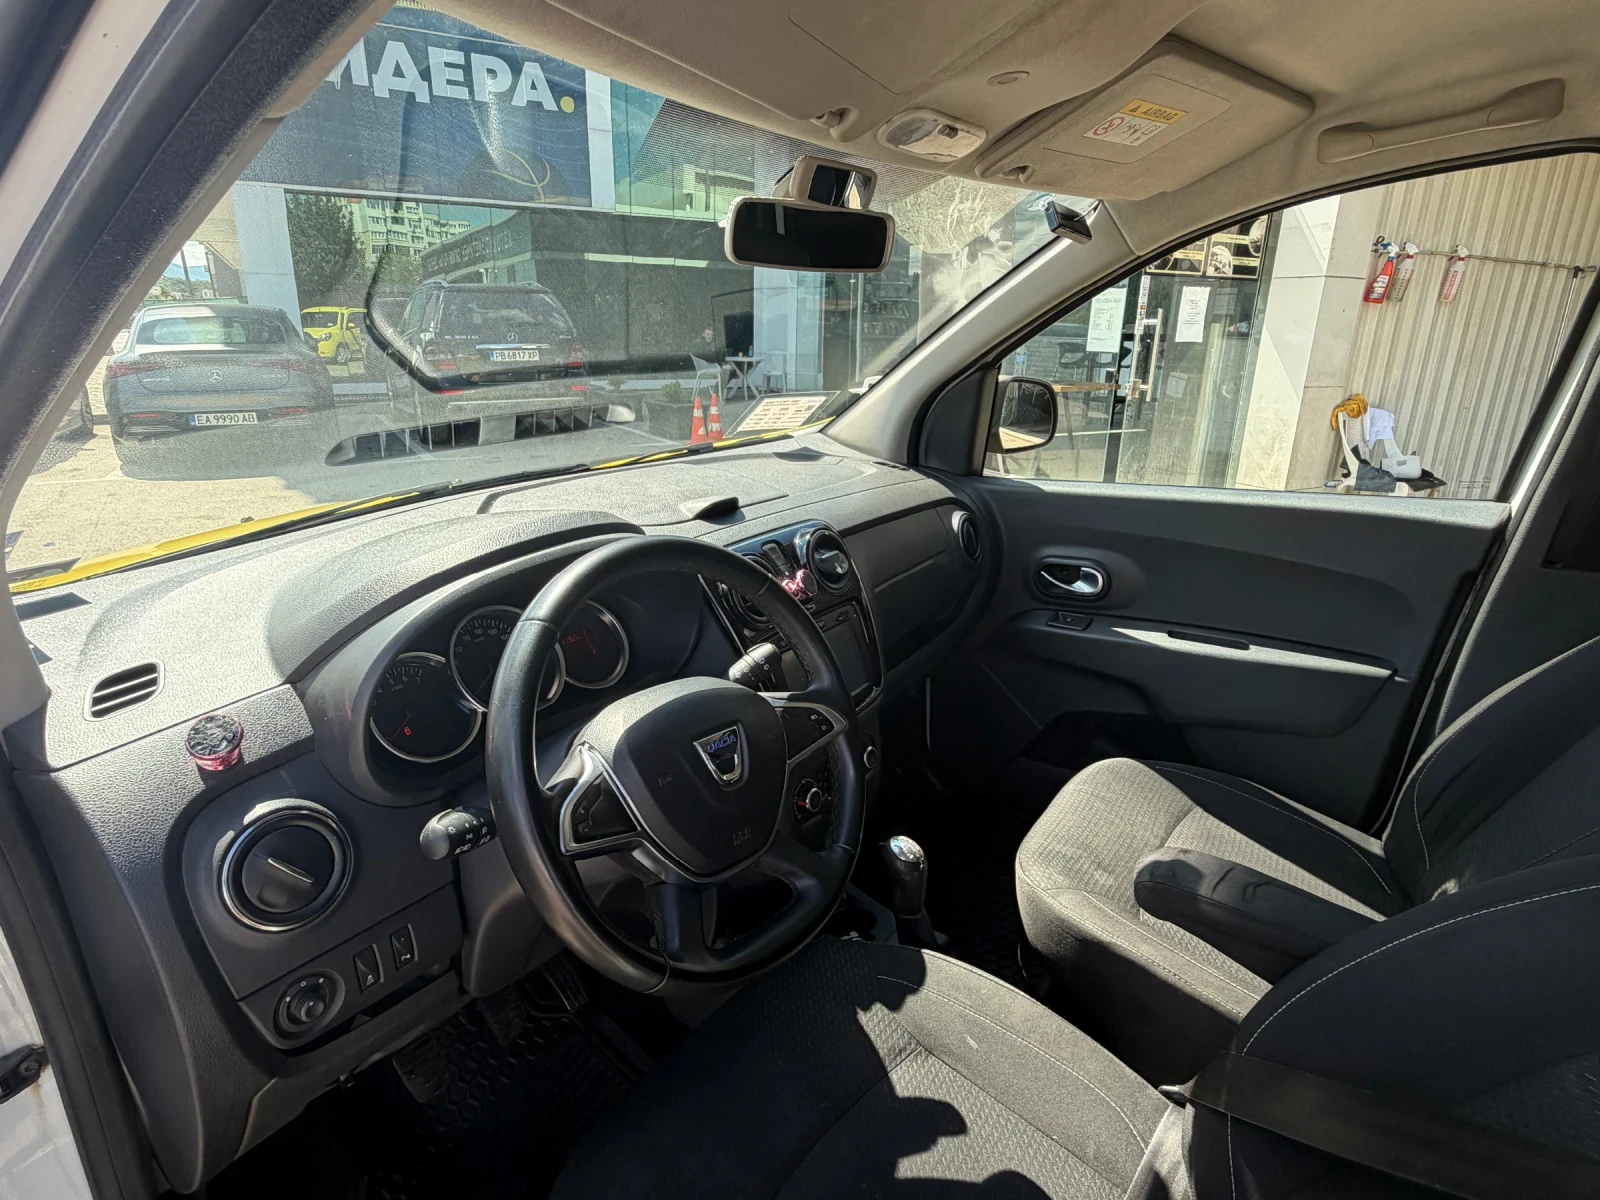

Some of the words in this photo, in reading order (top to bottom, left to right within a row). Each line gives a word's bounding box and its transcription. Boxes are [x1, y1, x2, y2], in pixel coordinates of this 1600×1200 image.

[1140, 107, 1178, 121] AIRBAG
[495, 352, 507, 361] PB
[507, 351, 526, 361] 6817
[527, 351, 538, 360] XP
[196, 415, 212, 425] EA
[213, 414, 239, 424] 9990
[241, 413, 256, 423] AB
[707, 734, 737, 753] DACIA
